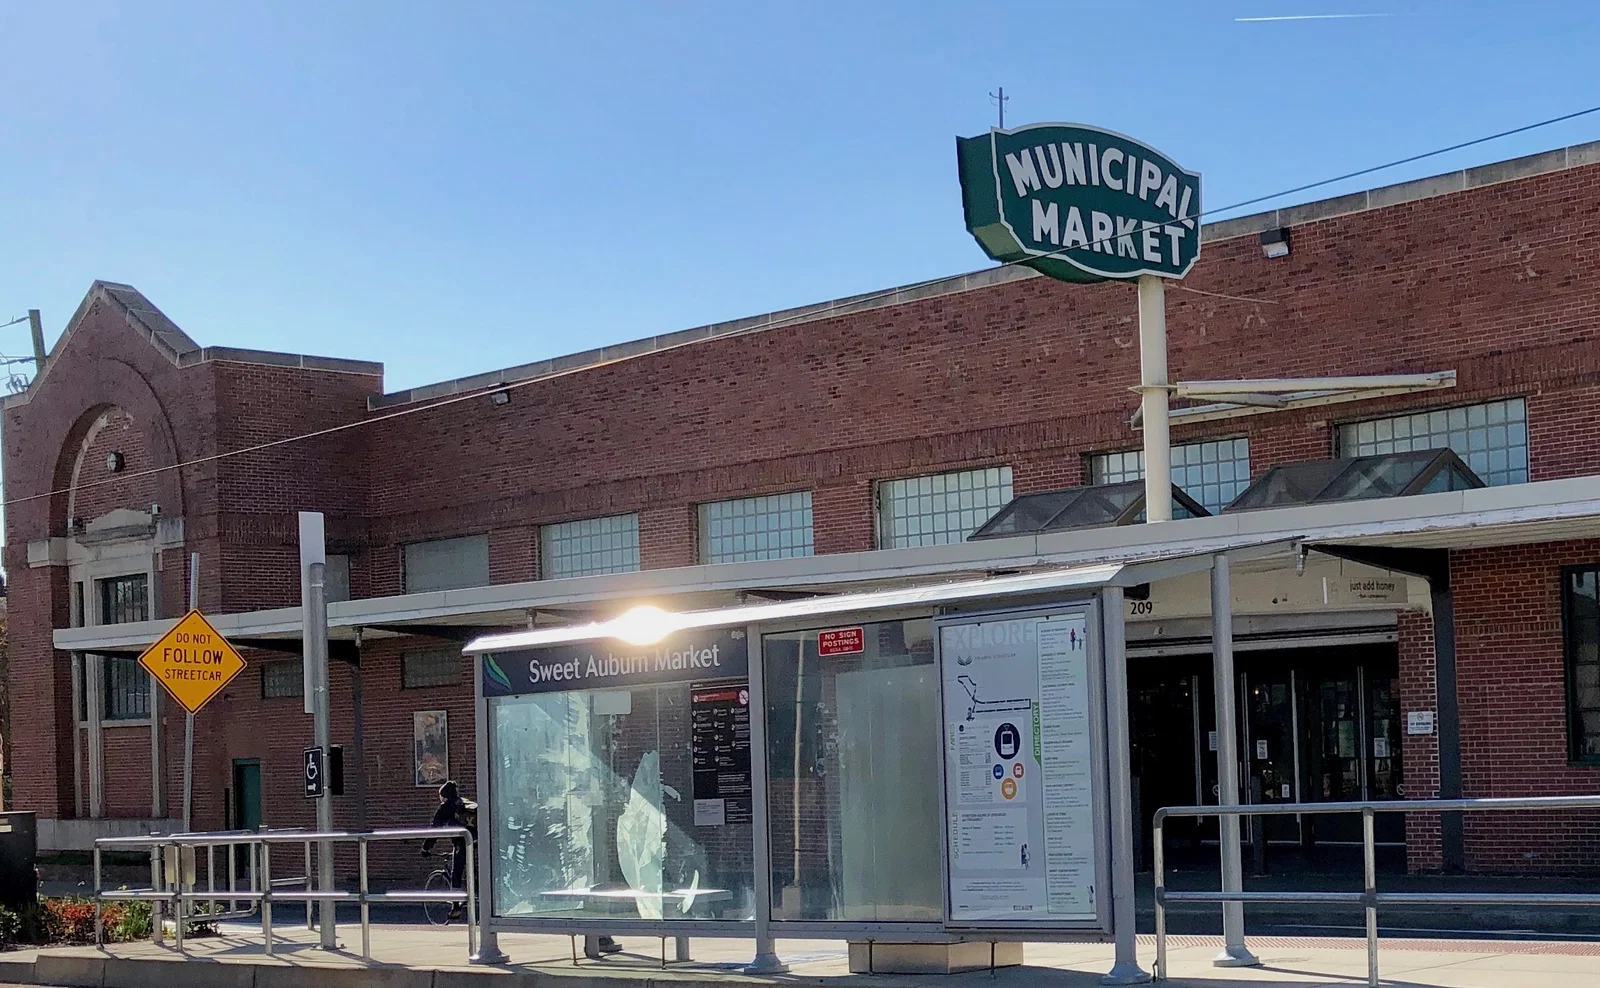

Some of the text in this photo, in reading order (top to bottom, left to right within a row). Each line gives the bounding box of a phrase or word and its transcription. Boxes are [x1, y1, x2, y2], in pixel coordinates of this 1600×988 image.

[1005, 142, 1195, 229] MUNICIPAL
[1031, 198, 1186, 266] MARKET
[1349, 580, 1395, 592] just add honey
[1130, 601, 1153, 615] 209
[176, 633, 211, 644] DO NOT
[823, 638, 860, 648] POSTINGS
[839, 631, 857, 639] SIGN
[945, 621, 1035, 650] EXPLORE
[163, 648, 223, 665] FOLLOW
[529, 644, 720, 683] Sweet Auburn Market
[164, 668, 222, 681] STREETCAR
[1033, 704, 1041, 756] DIRECTORY
[952, 812, 960, 860] SCHEDULE
